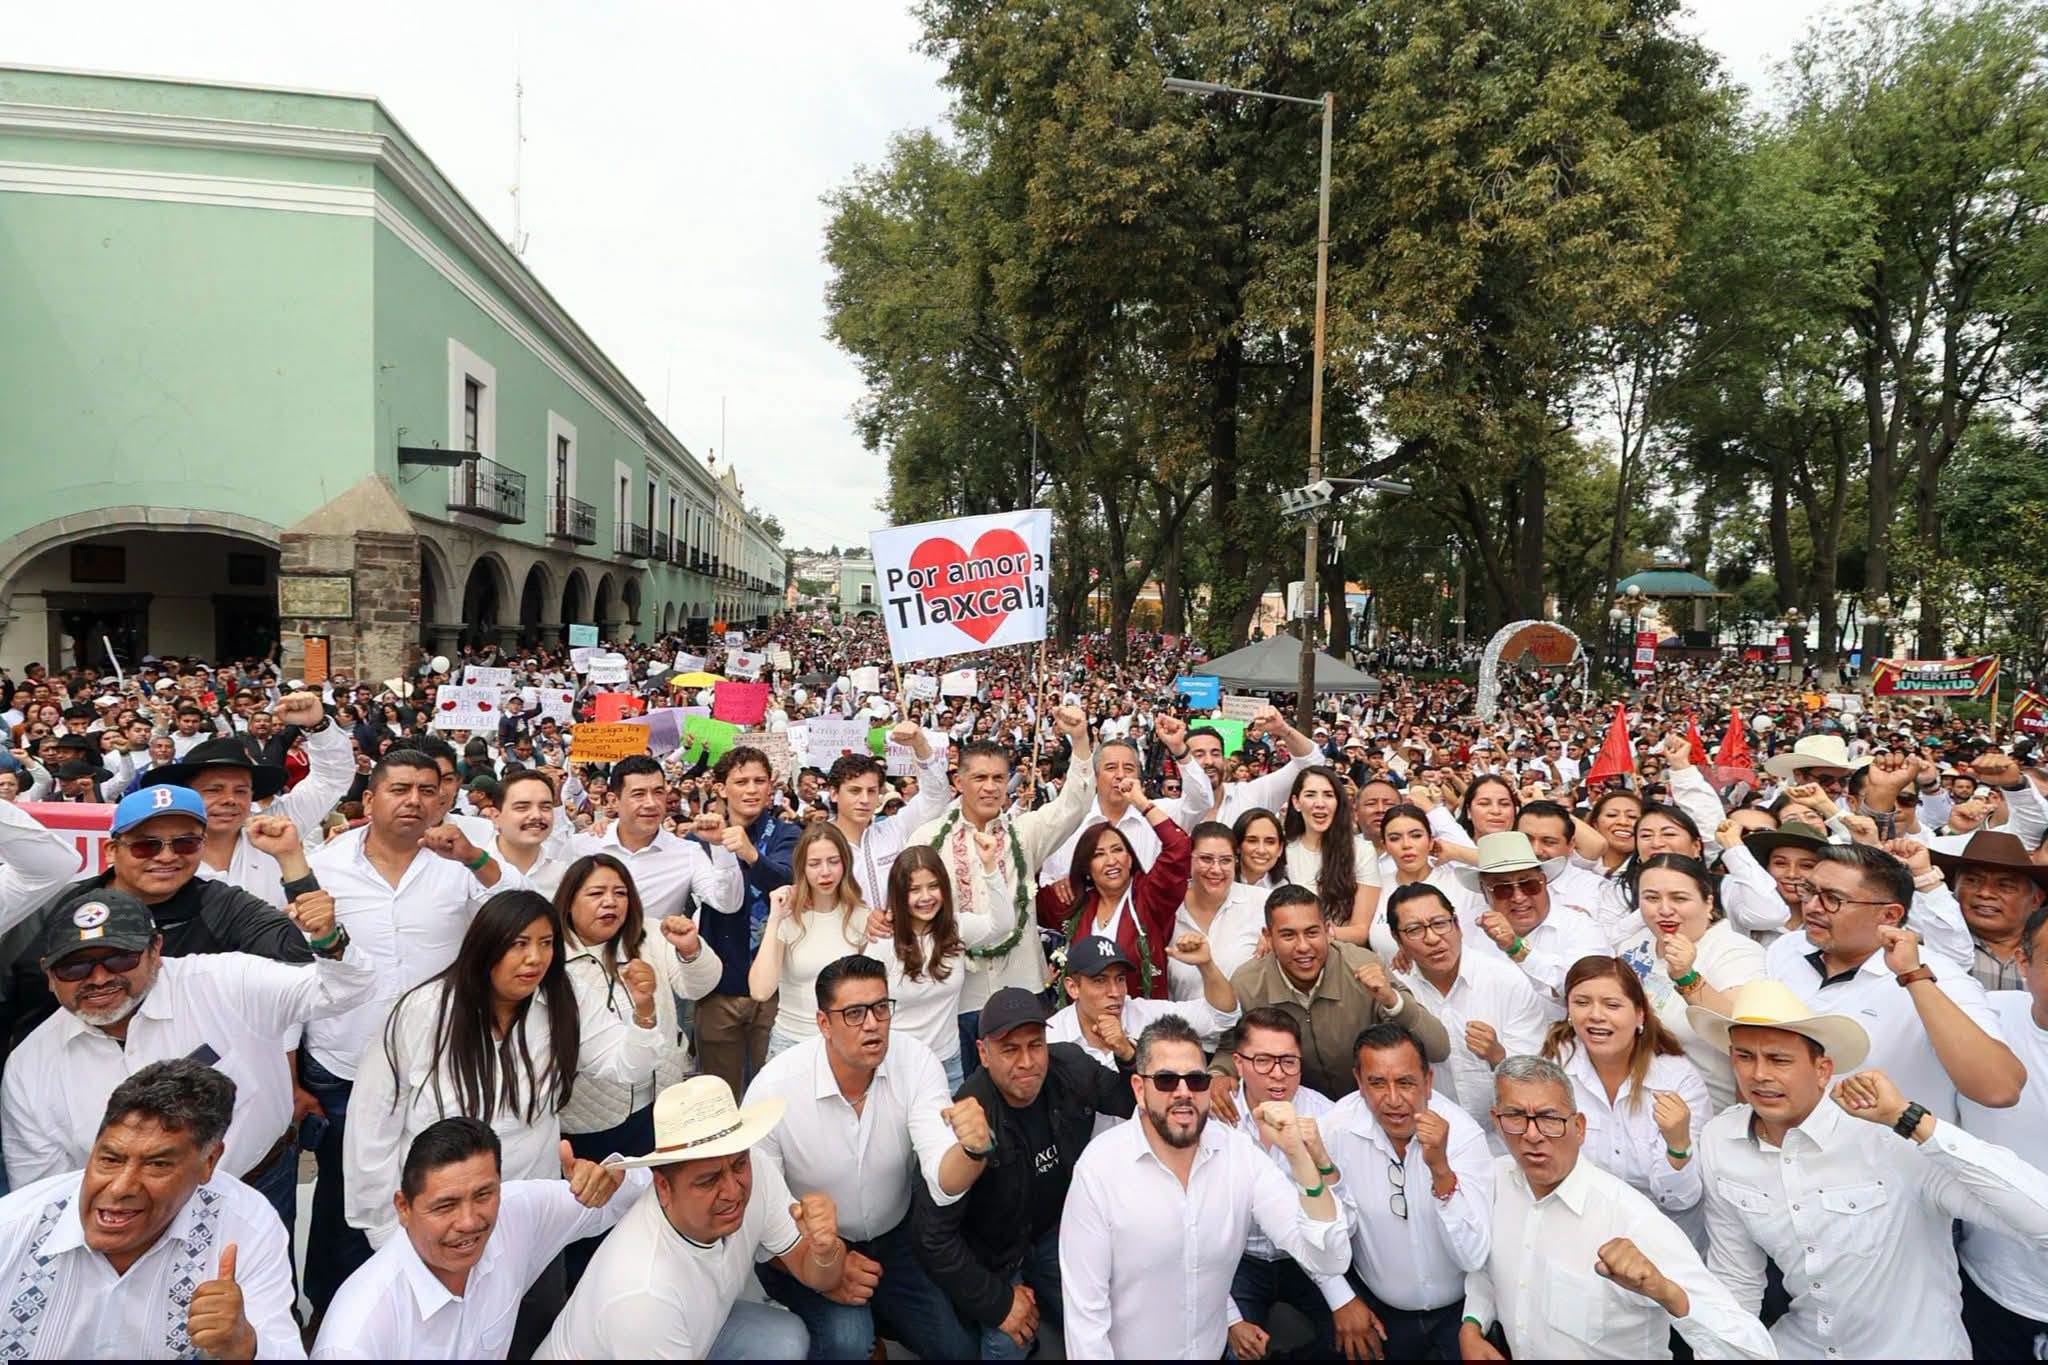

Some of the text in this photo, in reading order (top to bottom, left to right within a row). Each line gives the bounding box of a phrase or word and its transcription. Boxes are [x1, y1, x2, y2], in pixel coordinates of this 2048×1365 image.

[887, 552, 1044, 591] Por amor a
[889, 576, 1044, 629] Tlaxcala
[1902, 671, 1958, 680] FUERTE
[1893, 679, 1976, 690] JUVENTUD
[575, 724, 599, 733] Que
[600, 725, 624, 736] siga
[152, 788, 174, 809] B
[1097, 940, 1115, 956] NY
